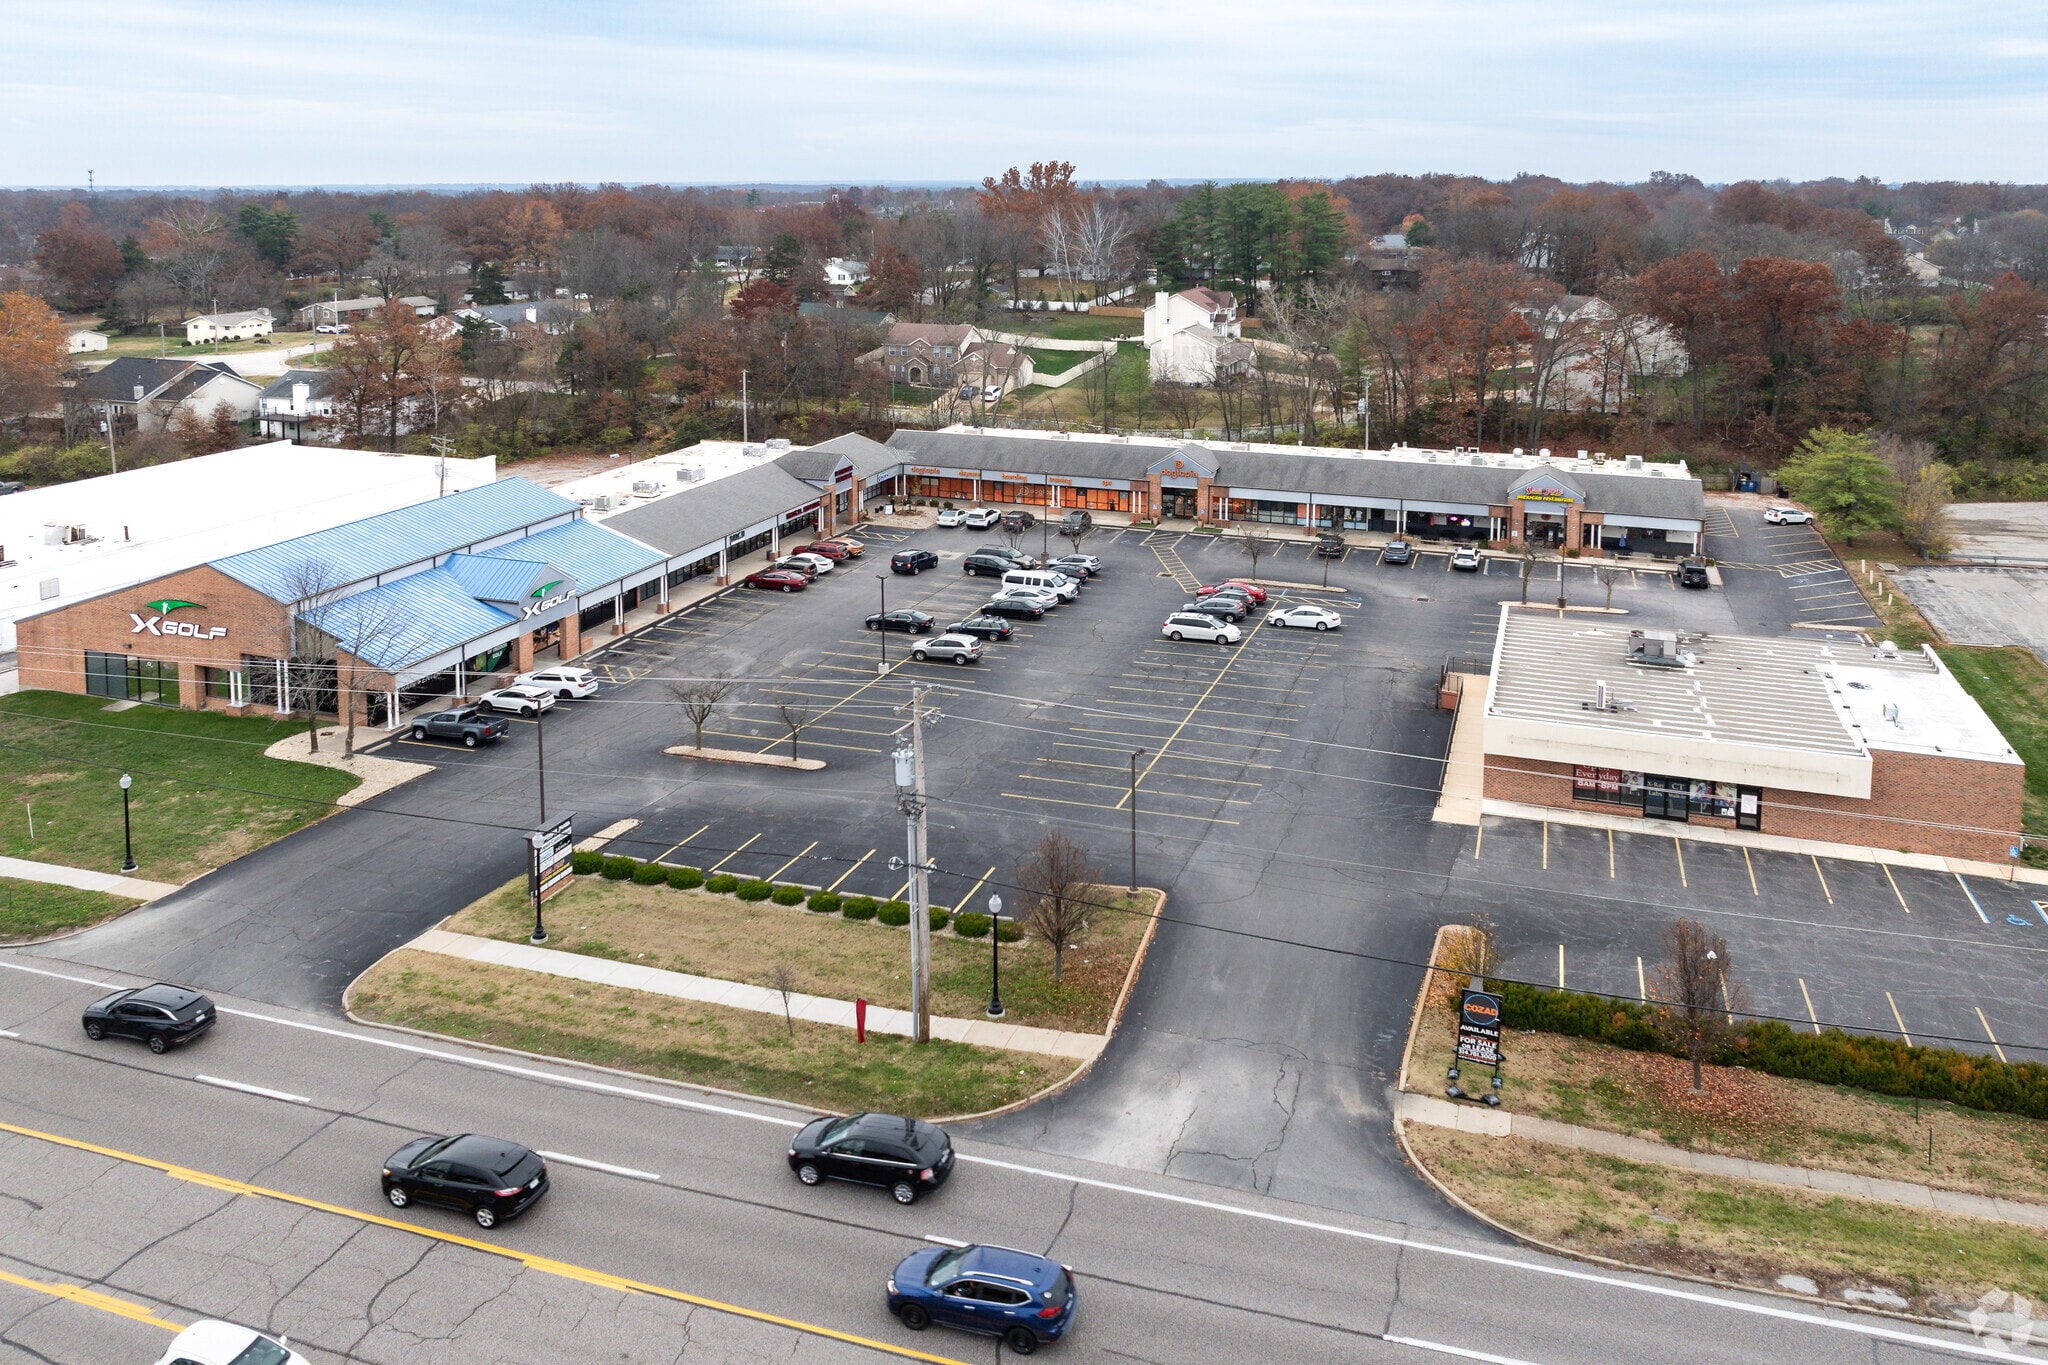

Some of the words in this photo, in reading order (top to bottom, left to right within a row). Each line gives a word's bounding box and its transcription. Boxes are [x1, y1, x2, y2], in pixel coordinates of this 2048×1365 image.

[1161, 468, 1198, 479] dogtopia
[1575, 768, 1619, 781] Everyday
[1671, 782, 1685, 791] CT
[1464, 1003, 1498, 1017] COZAD
[1460, 1024, 1499, 1038] AVAILABLE
[1460, 1036, 1476, 1045] FOR
[1477, 1039, 1497, 1049] SALE
[1472, 1045, 1494, 1054] LEASE
